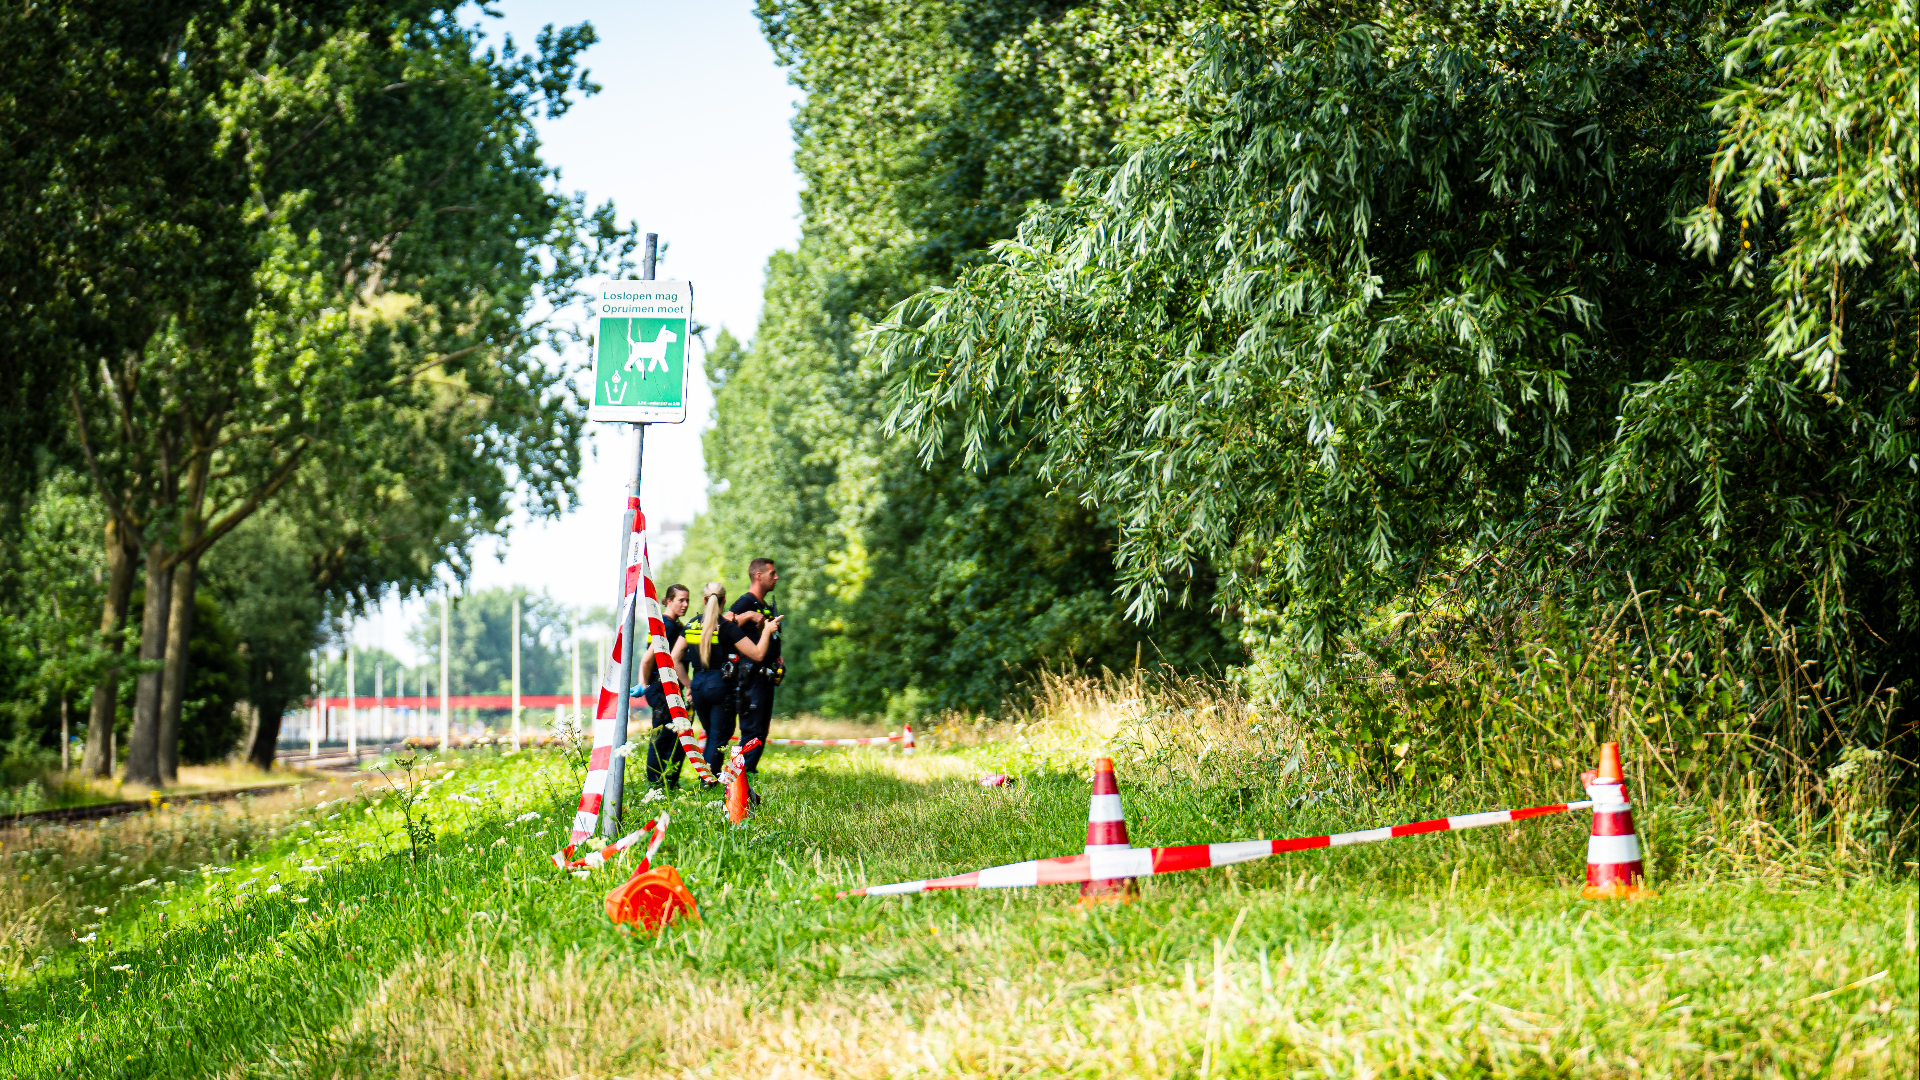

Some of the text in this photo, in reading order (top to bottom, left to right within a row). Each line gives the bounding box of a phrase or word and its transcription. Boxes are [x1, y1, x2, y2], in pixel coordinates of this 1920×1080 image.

[603, 291, 678, 303] Loslopen mag
[602, 304, 684, 315] Opruimen moet
